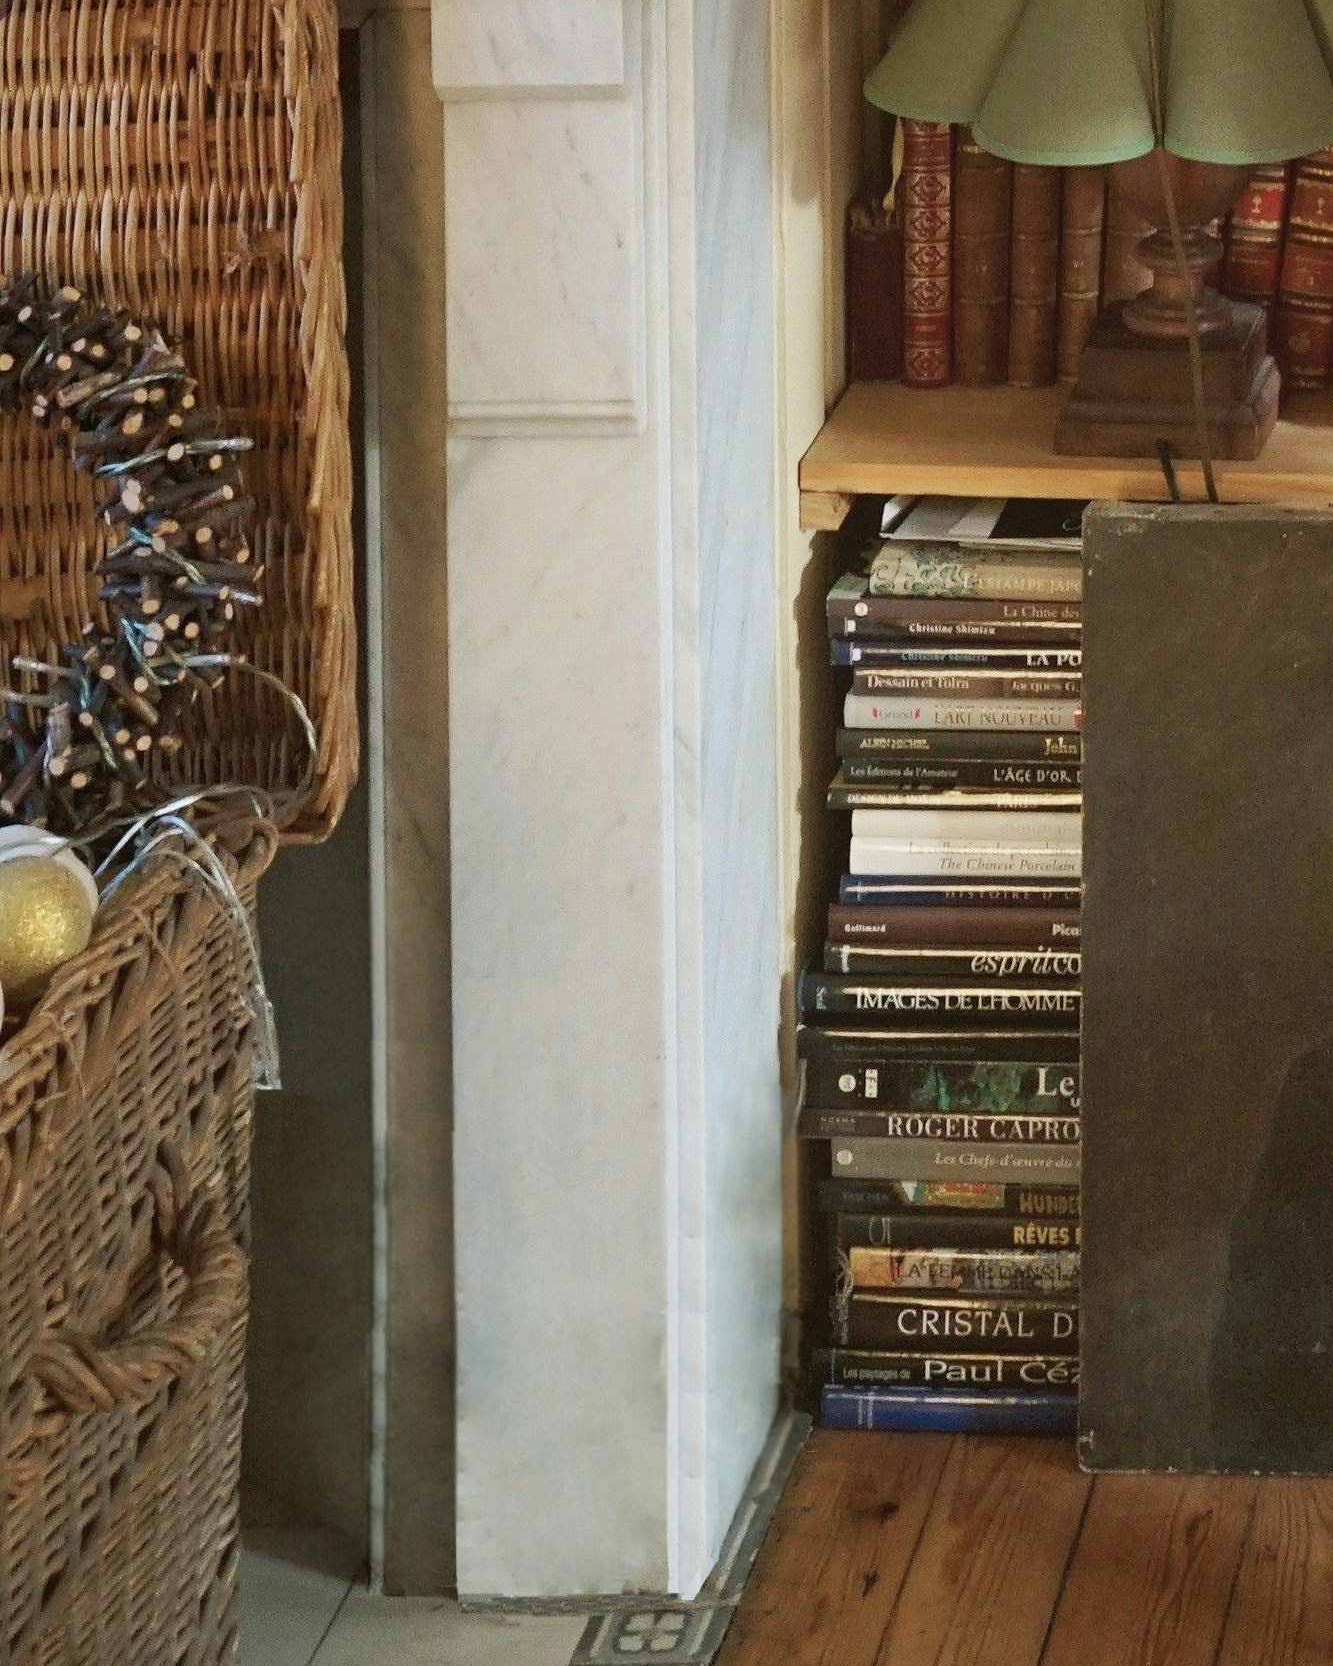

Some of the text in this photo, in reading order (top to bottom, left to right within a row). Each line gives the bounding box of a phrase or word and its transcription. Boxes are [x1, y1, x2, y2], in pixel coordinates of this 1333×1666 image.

[1021, 605, 1054, 619] Chine
[908, 623, 952, 634] Christine
[1026, 652, 1050, 667] LA
[867, 675, 919, 689] Dessain
[920, 677, 934, 688] et
[980, 705, 1062, 725] NOUVEAU
[1043, 735, 1078, 756] John
[903, 766, 914, 778] de
[993, 765, 1033, 783] L'ÂGE
[1036, 767, 1072, 784] D'OR
[939, 857, 1076, 872] The Chinese Porcelain
[844, 923, 887, 934] Gallimard
[855, 987, 940, 1011] IMAGES
[943, 990, 973, 1011] DE
[1037, 1066, 1075, 1097] Le
[887, 1115, 1081, 1141] ROGER CAPRO
[935, 1151, 957, 1166] Les
[1013, 1221, 1070, 1245] RÊVES
[897, 1308, 1035, 1338] CRISTAL
[924, 1359, 1003, 1382] Paul
